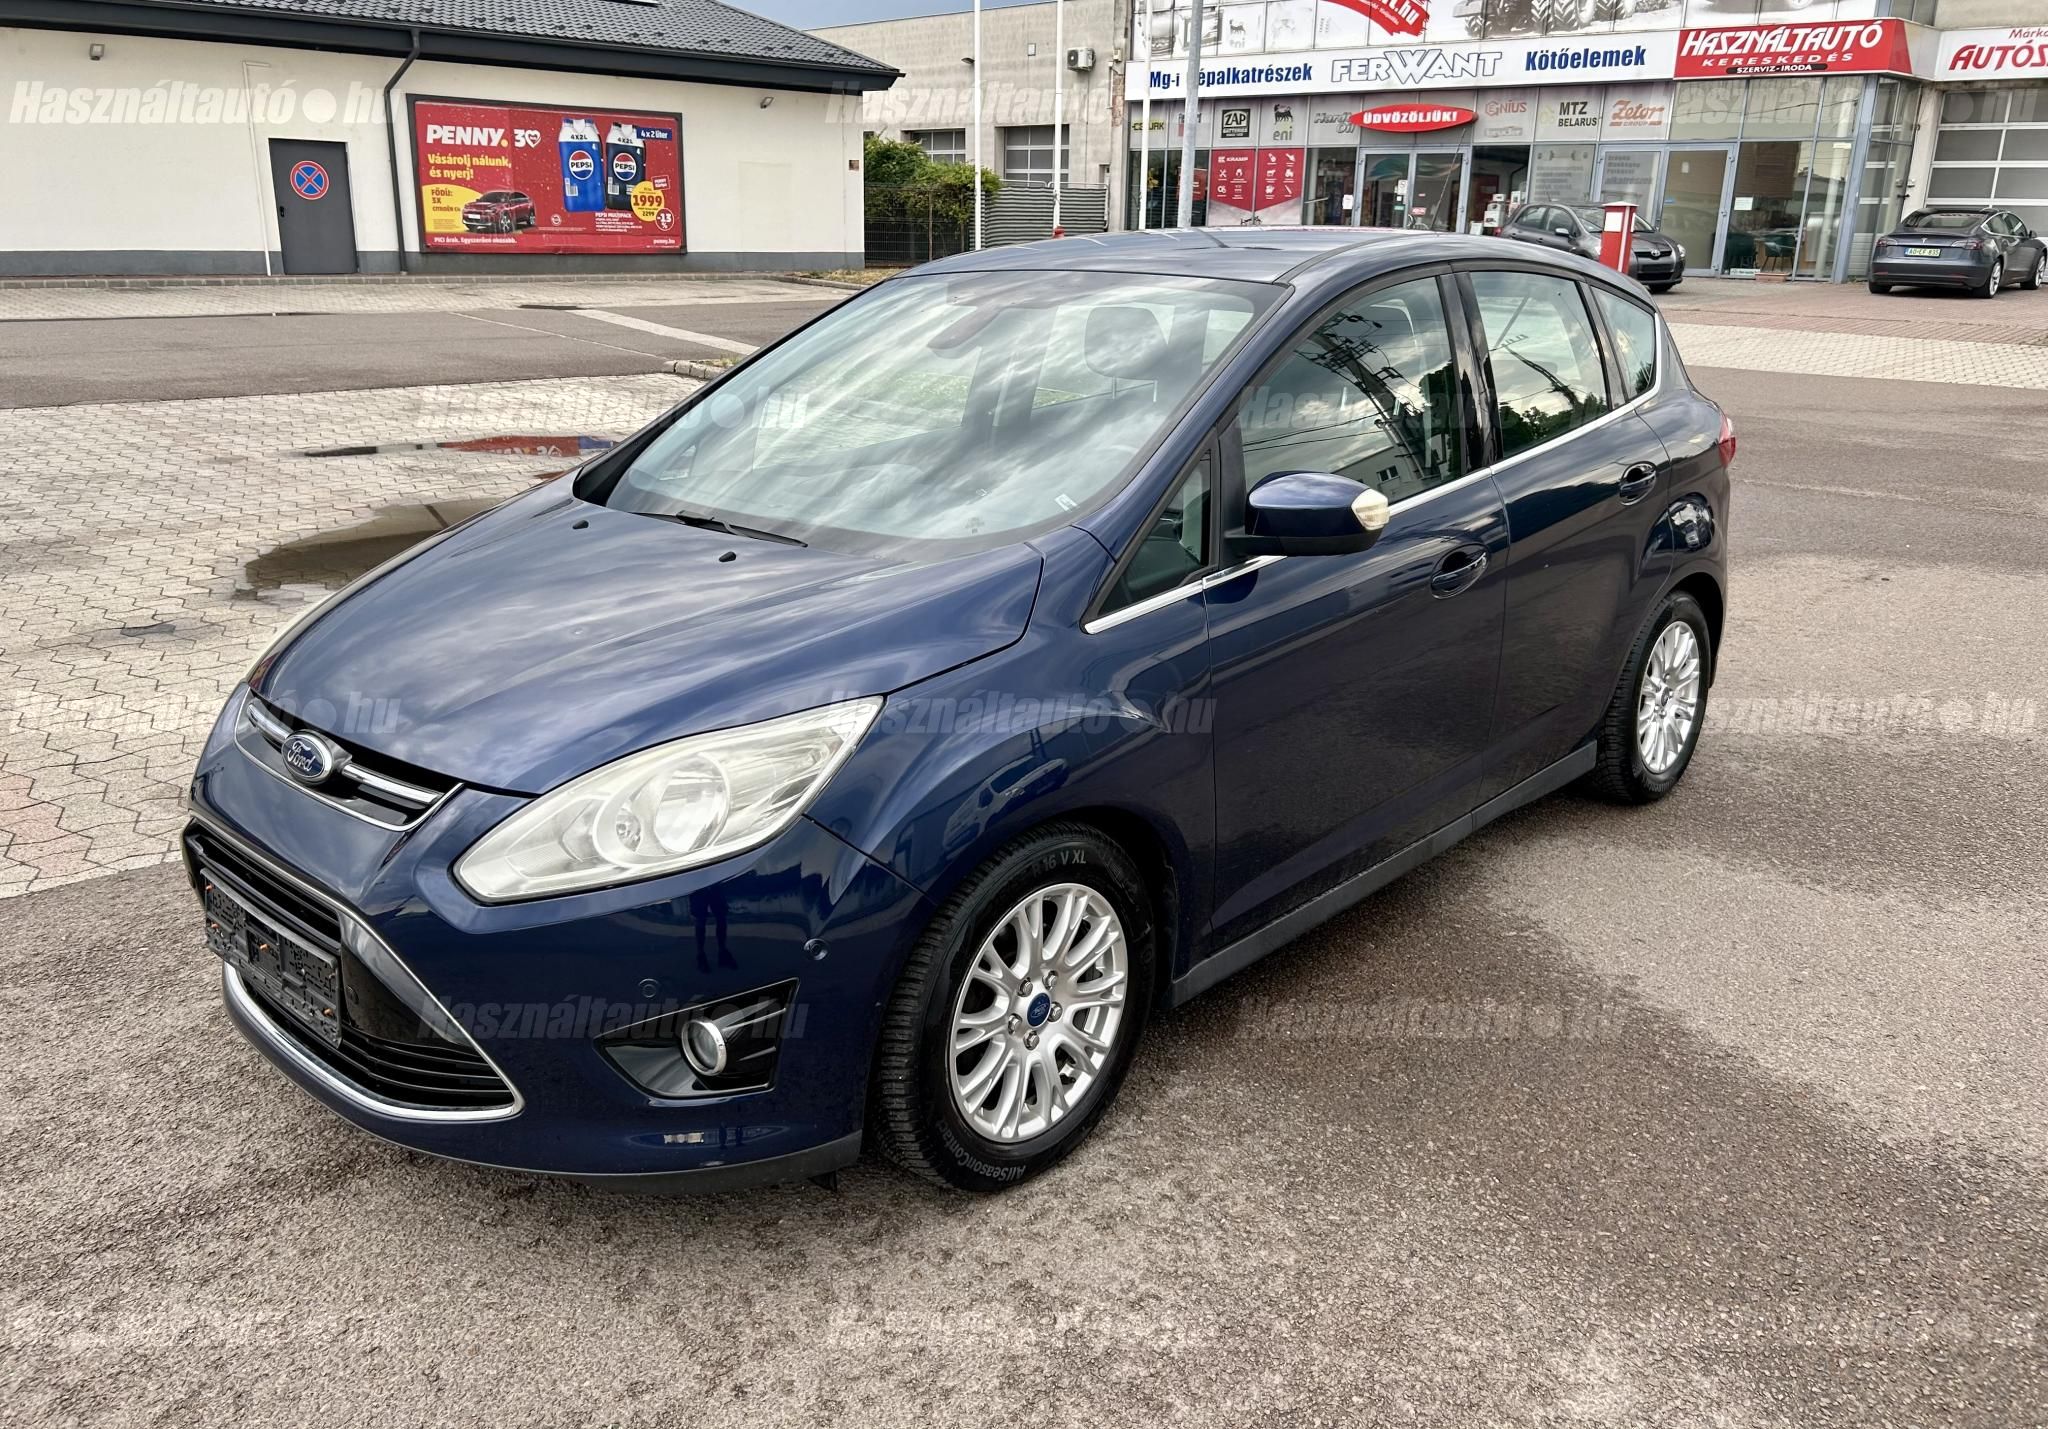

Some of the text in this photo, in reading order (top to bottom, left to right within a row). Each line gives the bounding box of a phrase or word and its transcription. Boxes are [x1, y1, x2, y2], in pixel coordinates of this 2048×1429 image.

[1681, 20, 1883, 56] HASZNÁLTAUTÓ
[1526, 44, 1646, 72] Kötőelemek
[1702, 52, 1854, 67] KERESKEDÉS
[1949, 40, 2048, 71] AUTÓS
[1331, 48, 1502, 85] FERWANT
[1198, 63, 1312, 87] épalkatrészek
[1559, 101, 1588, 116] MTZ
[1612, 99, 1664, 120] Zetor
[1224, 112, 1247, 126] ZAP
[1363, 111, 1457, 124] ÜDVÖZÖLJÜK!
[1558, 117, 1597, 127] BELARUS
[1273, 126, 1293, 141] eni
[428, 153, 512, 169] Vásárolj nálunk,
[614, 162, 635, 171] PEPSI
[429, 166, 474, 180] és nyerj!
[633, 194, 662, 207] 1999
[287, 741, 316, 771] Ford
[1060, 850, 1069, 865] V
[1072, 849, 1087, 865] XL
